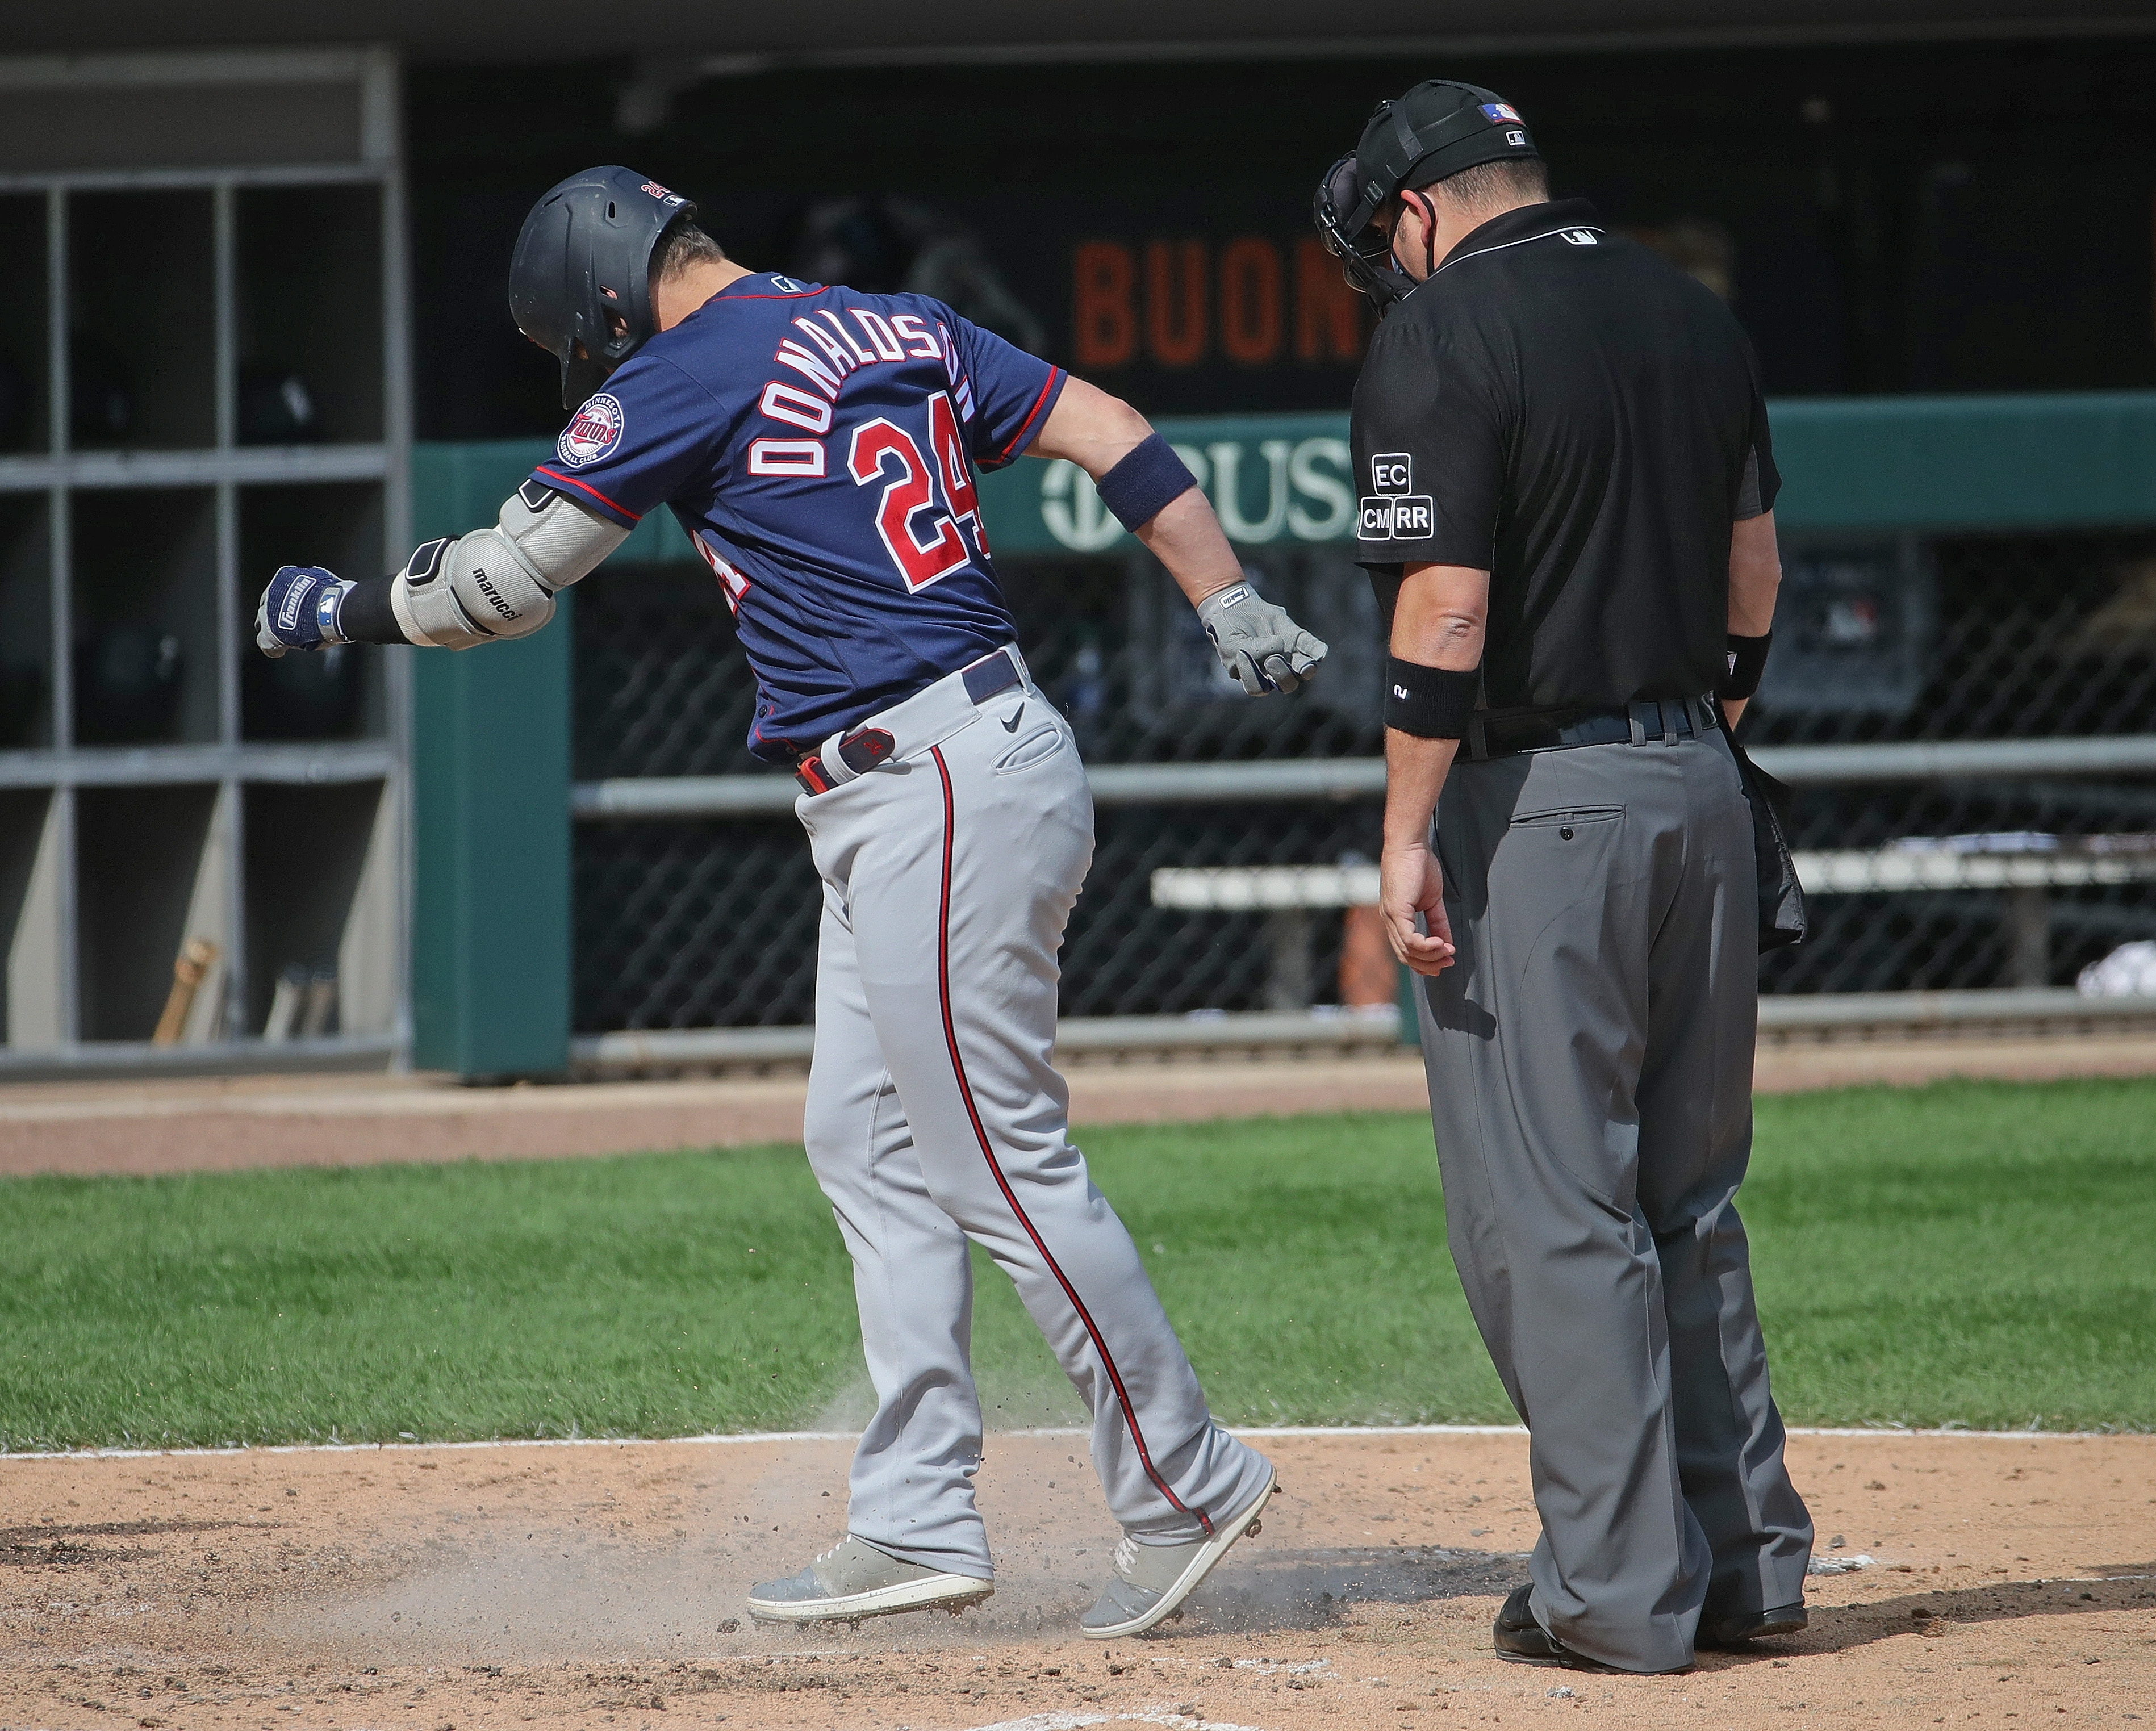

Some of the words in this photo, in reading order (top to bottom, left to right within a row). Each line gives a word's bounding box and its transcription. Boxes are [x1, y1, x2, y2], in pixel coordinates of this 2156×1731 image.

[566, 413, 617, 444] Twins
[584, 397, 621, 429] MINNESOTA
[559, 436, 578, 463] BASEBALL
[579, 454, 598, 463] CLUB
[1170, 437, 1352, 542] US
[1375, 464, 1407, 487] EC
[846, 390, 991, 595] 24
[1363, 508, 1390, 528] CM
[1397, 507, 1428, 529] RR
[281, 578, 311, 627] Franklin
[473, 568, 523, 621] marucci
[863, 738, 884, 756] 24
